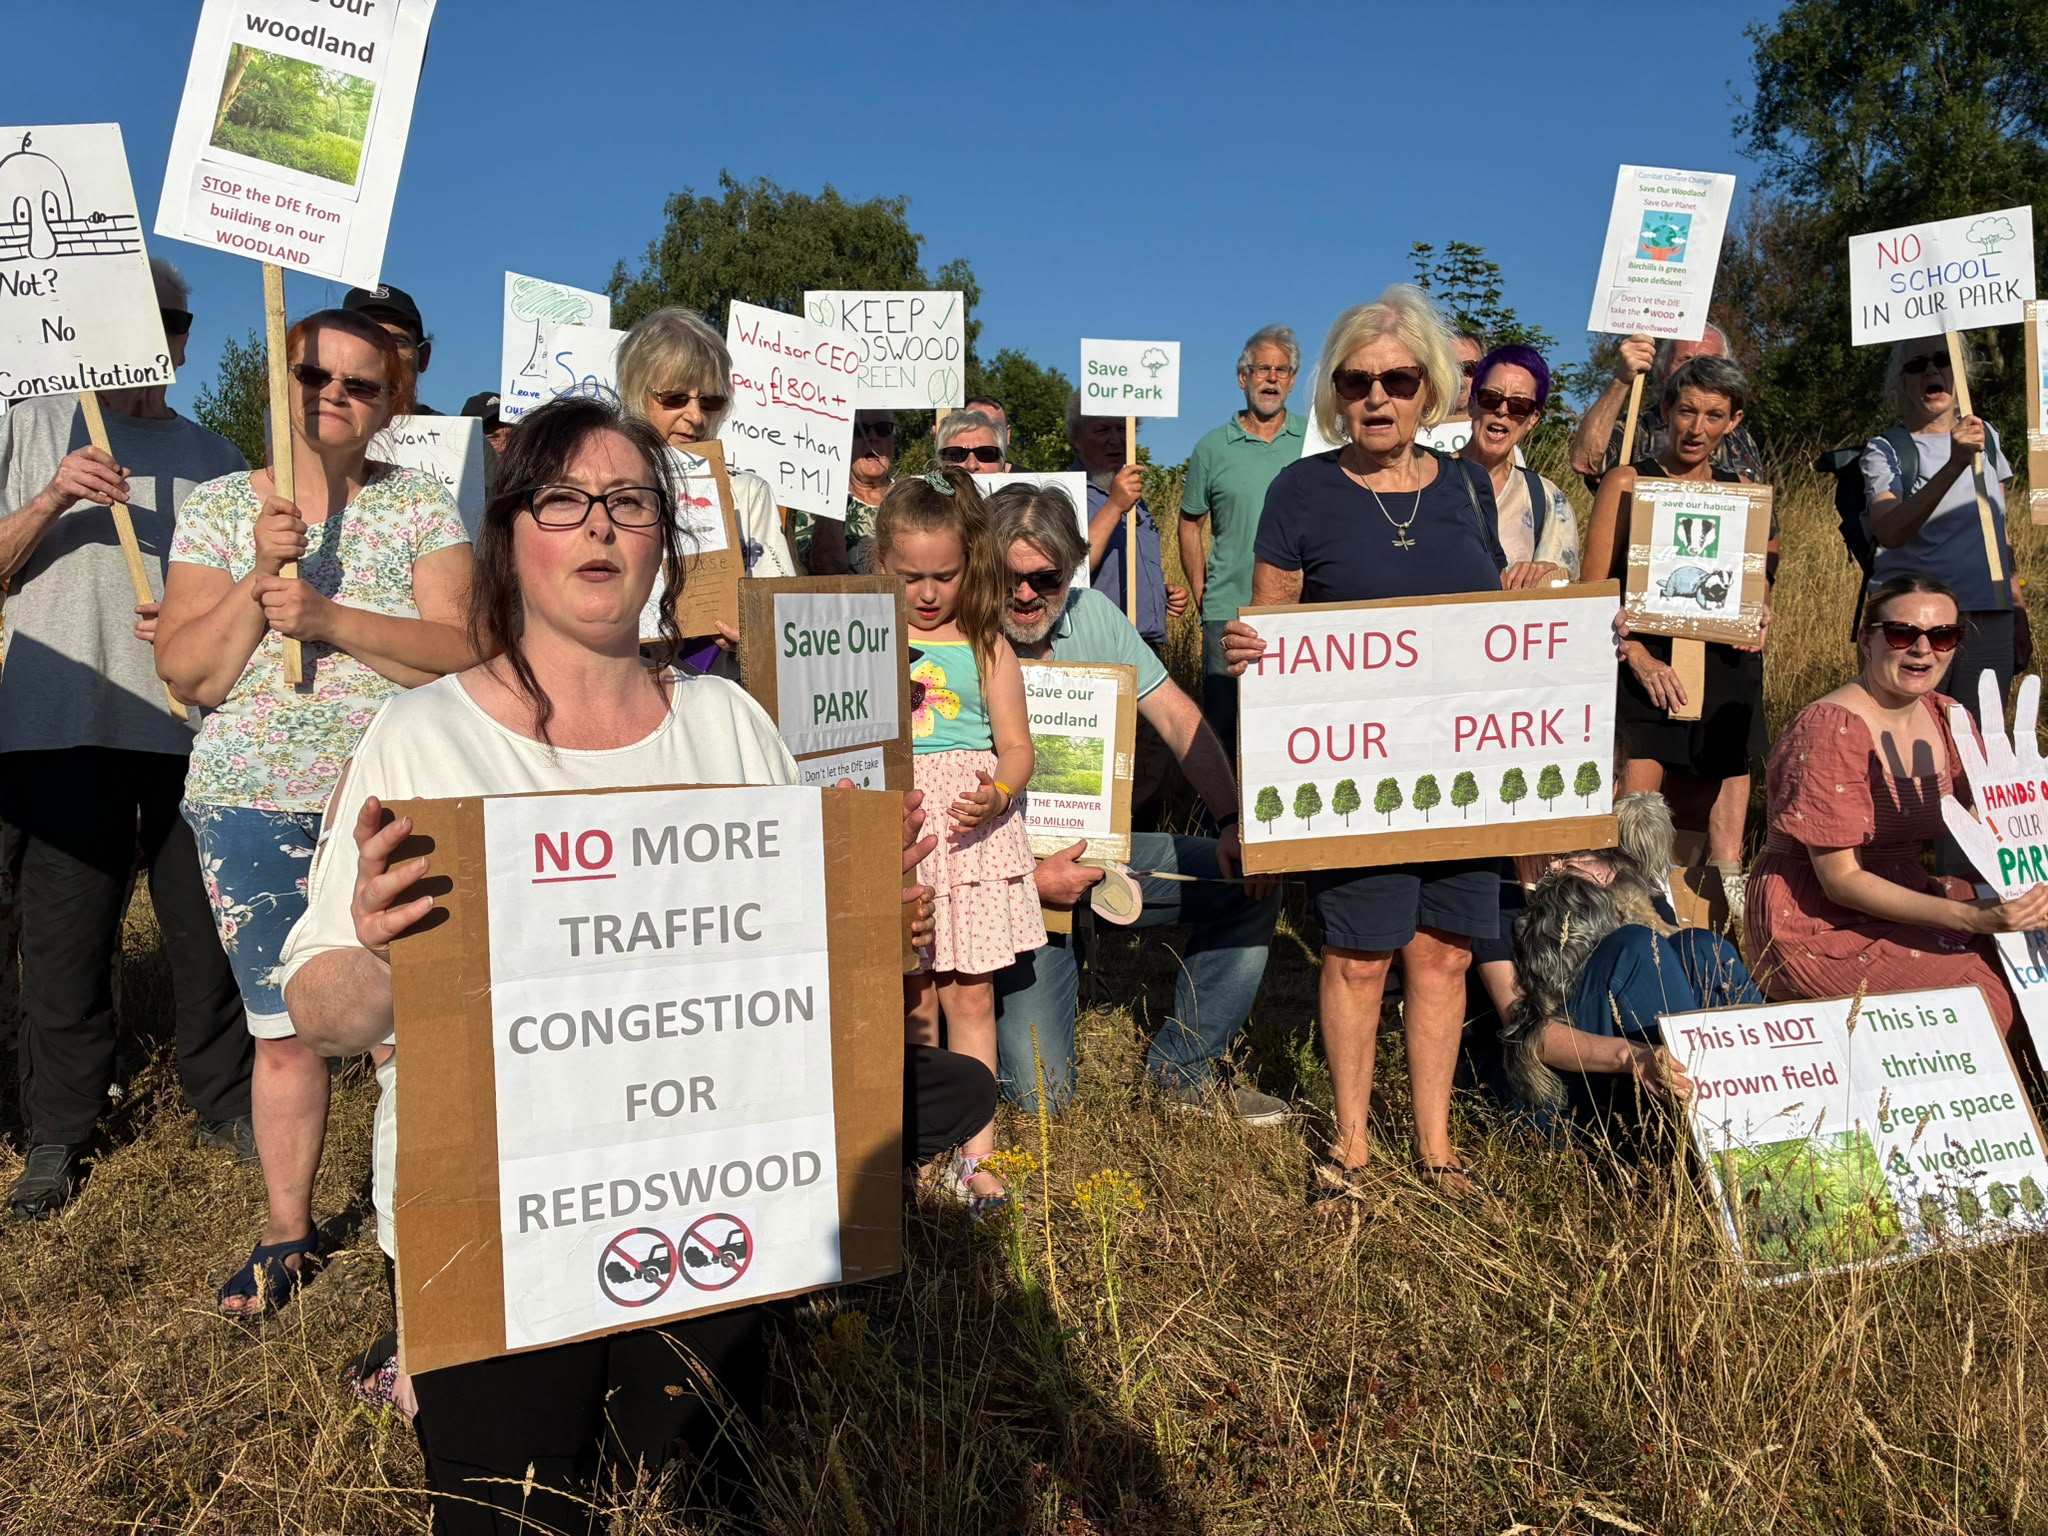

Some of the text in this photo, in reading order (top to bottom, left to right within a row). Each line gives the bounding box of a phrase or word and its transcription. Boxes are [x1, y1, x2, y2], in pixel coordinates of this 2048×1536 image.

[246, 14, 375, 63] woodland
[1638, 172, 1712, 185] Combat Climate Change
[1672, 188, 1706, 197] Woodland
[201, 175, 341, 223] STOP the DfE from
[1643, 199, 1696, 210] Save Our Planet
[210, 203, 326, 244] building on our
[216, 229, 310, 265] WOODLAND
[1877, 233, 1921, 270] NO
[1628, 262, 1657, 271] Birchills
[1658, 264, 1664, 272] is
[1628, 275, 1682, 286] space deficient
[1890, 258, 2000, 294] SCHOOL
[842, 298, 926, 334] KEEP
[1610, 306, 1675, 319] take the WOOD
[1621, 294, 1680, 307] Don't let the DfE
[1863, 278, 2023, 329] IN OUR PARK
[42, 316, 76, 343] No
[1636, 323, 1678, 333] Reedswood
[735, 314, 859, 374] Windsor CEO
[859, 336, 959, 363] DSWOOD
[0, 354, 169, 397] Consultation?
[857, 365, 916, 388] REEN
[1088, 360, 1128, 376] Save
[510, 379, 541, 399] Leave
[732, 374, 766, 406] pay
[1088, 382, 1162, 399] Our Park
[732, 420, 840, 462] more than
[1686, 501, 1702, 509] our
[1703, 502, 1737, 512] habitat
[783, 620, 889, 658] Save Our
[1257, 621, 1569, 676] HANDS OFF
[813, 689, 868, 725] PARK
[1026, 683, 1094, 701] Save our
[1287, 721, 1388, 765] OUR
[1454, 707, 1565, 753] PARK
[805, 758, 879, 782] Don't let the DfE take
[1033, 798, 1051, 808] THE
[1054, 799, 1101, 811] TAXPAYER
[1982, 780, 2036, 811] HANDS
[1043, 817, 1085, 829] MILLION
[2008, 814, 2043, 838] OUR
[532, 819, 780, 881] NO MORE
[558, 902, 762, 957] TRAFFIC
[508, 986, 814, 1055] CONGESTION
[1680, 1017, 1822, 1051] This is NOT
[1862, 1005, 1958, 1032] This is a
[1881, 1049, 1976, 1078] thriving
[1694, 1061, 1839, 1100] brown field
[626, 1075, 717, 1122] FOR
[1950, 1092, 2015, 1121] space
[1891, 1132, 2035, 1176] & woodland
[518, 1150, 821, 1233] REEDSWOOD
